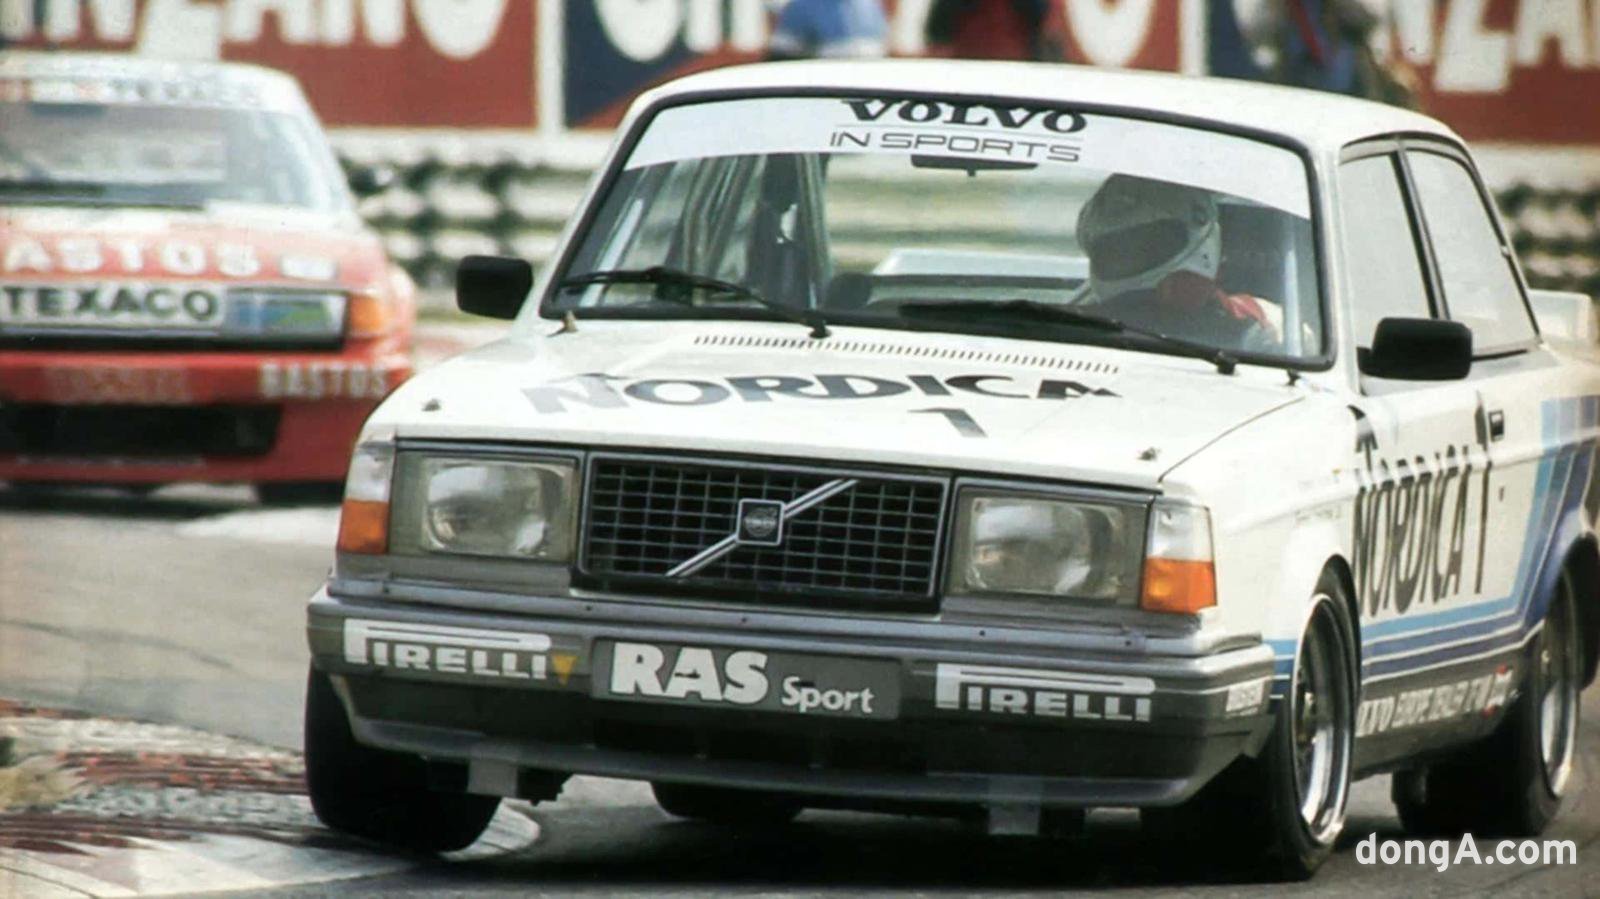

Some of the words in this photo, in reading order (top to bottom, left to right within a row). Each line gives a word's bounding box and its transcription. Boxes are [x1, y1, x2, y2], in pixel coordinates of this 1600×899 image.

[841, 99, 1087, 134] VOLVO
[830, 131, 871, 148] IN
[880, 133, 1082, 163] SPORTS
[1, 284, 217, 322] TEXACO
[520, 372, 1123, 412] NORDICA
[343, 617, 552, 681] PIRELLI
[610, 641, 769, 704] RAS
[781, 676, 875, 714] Sport
[935, 662, 1156, 723] PIRELLI
